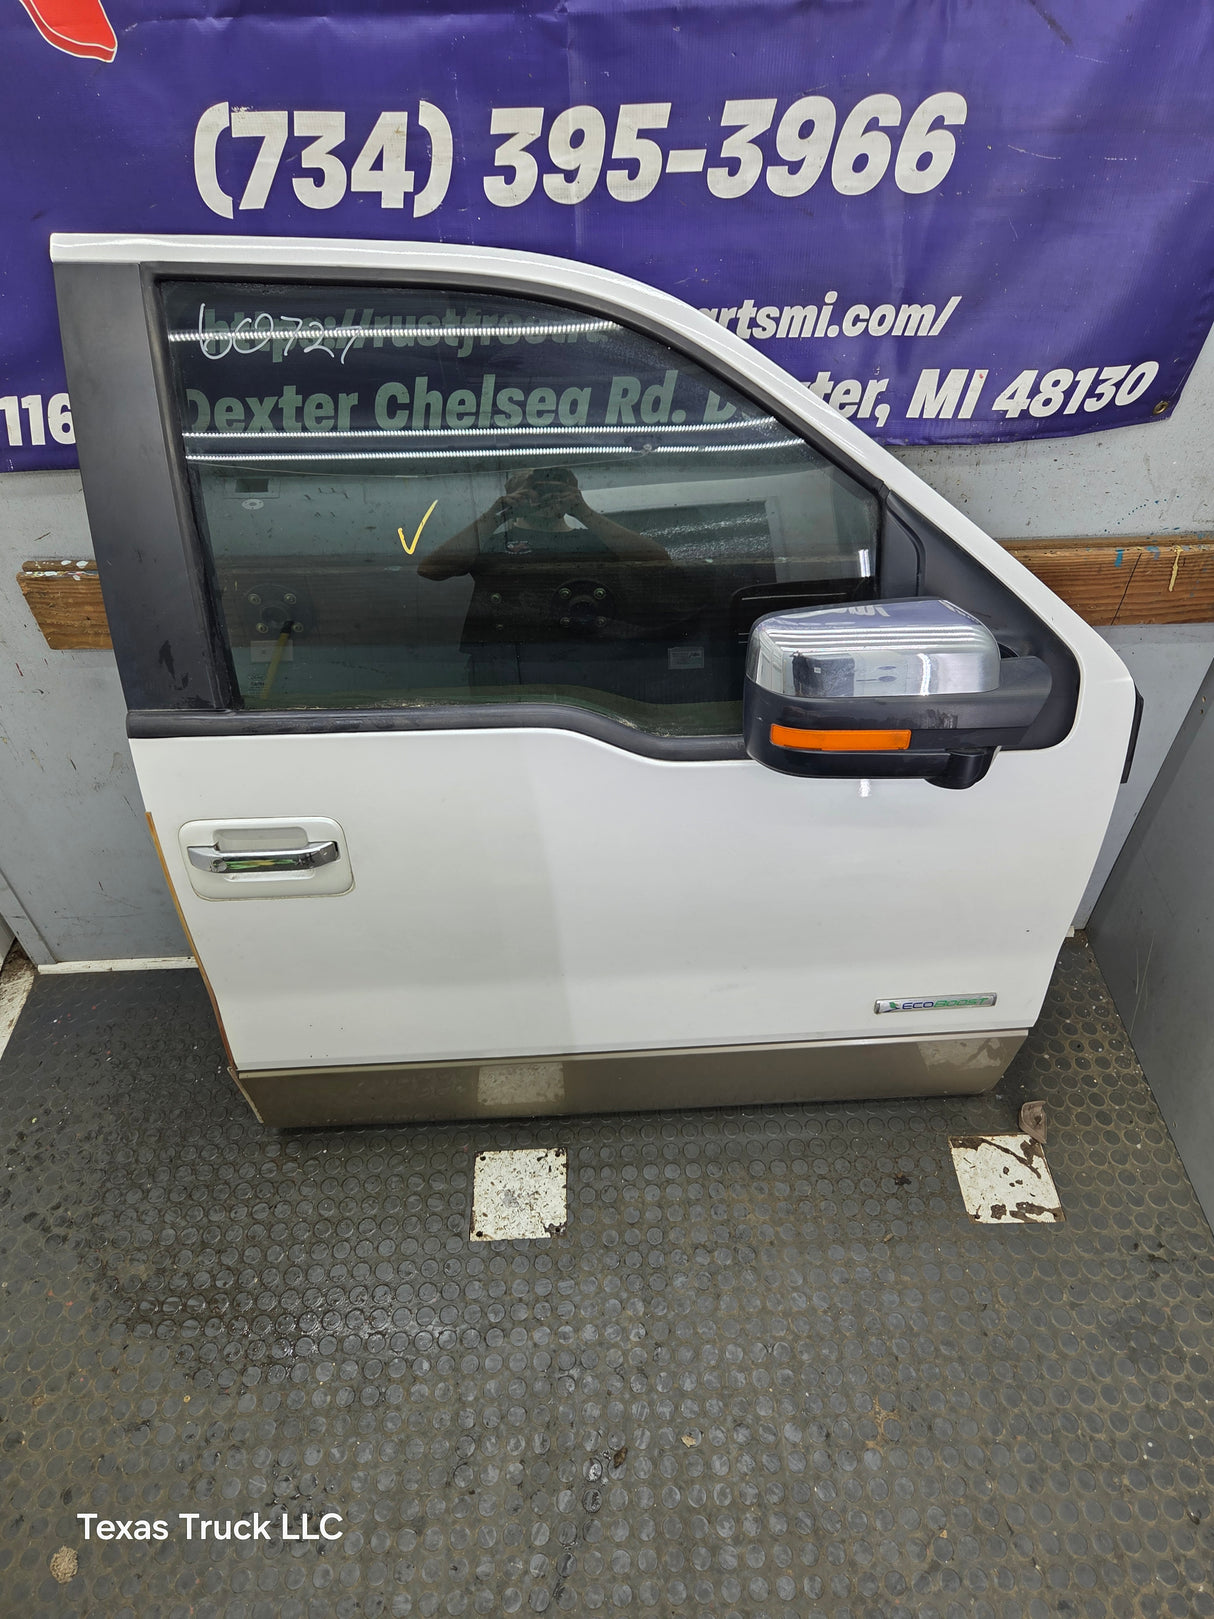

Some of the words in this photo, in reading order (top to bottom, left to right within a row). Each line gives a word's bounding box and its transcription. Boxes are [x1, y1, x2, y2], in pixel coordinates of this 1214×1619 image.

[194, 100, 453, 220] (734)
[483, 91, 968, 207] 395-3966
[186, 384, 358, 433] Dexter
[374, 373, 592, 431] Chelsea
[605, 369, 687, 425] Rd.
[905, 368, 988, 419] MI
[992, 360, 1160, 418] 48130
